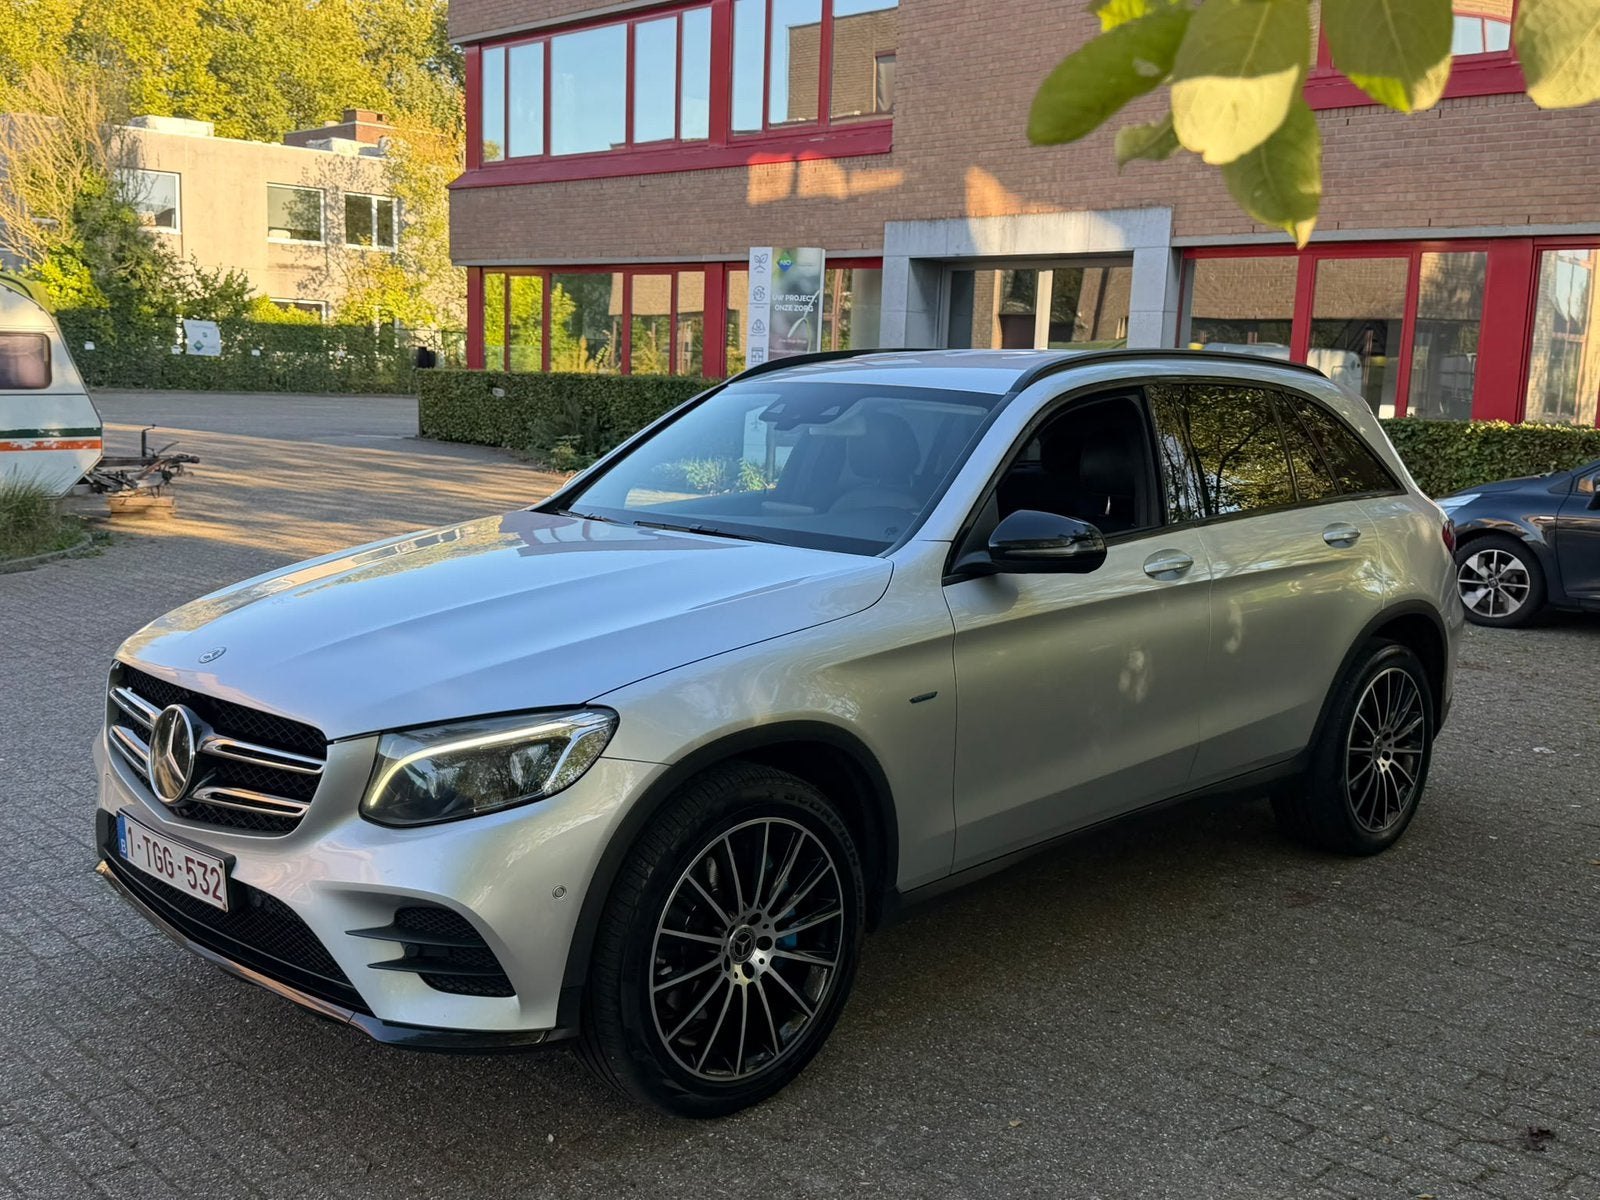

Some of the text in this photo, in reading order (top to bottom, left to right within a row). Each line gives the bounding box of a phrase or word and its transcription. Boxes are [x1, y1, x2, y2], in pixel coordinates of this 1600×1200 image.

[774, 304, 814, 312] ONZE ZORG
[121, 838, 127, 853] B
[127, 826, 223, 902] 1-TGG-532
